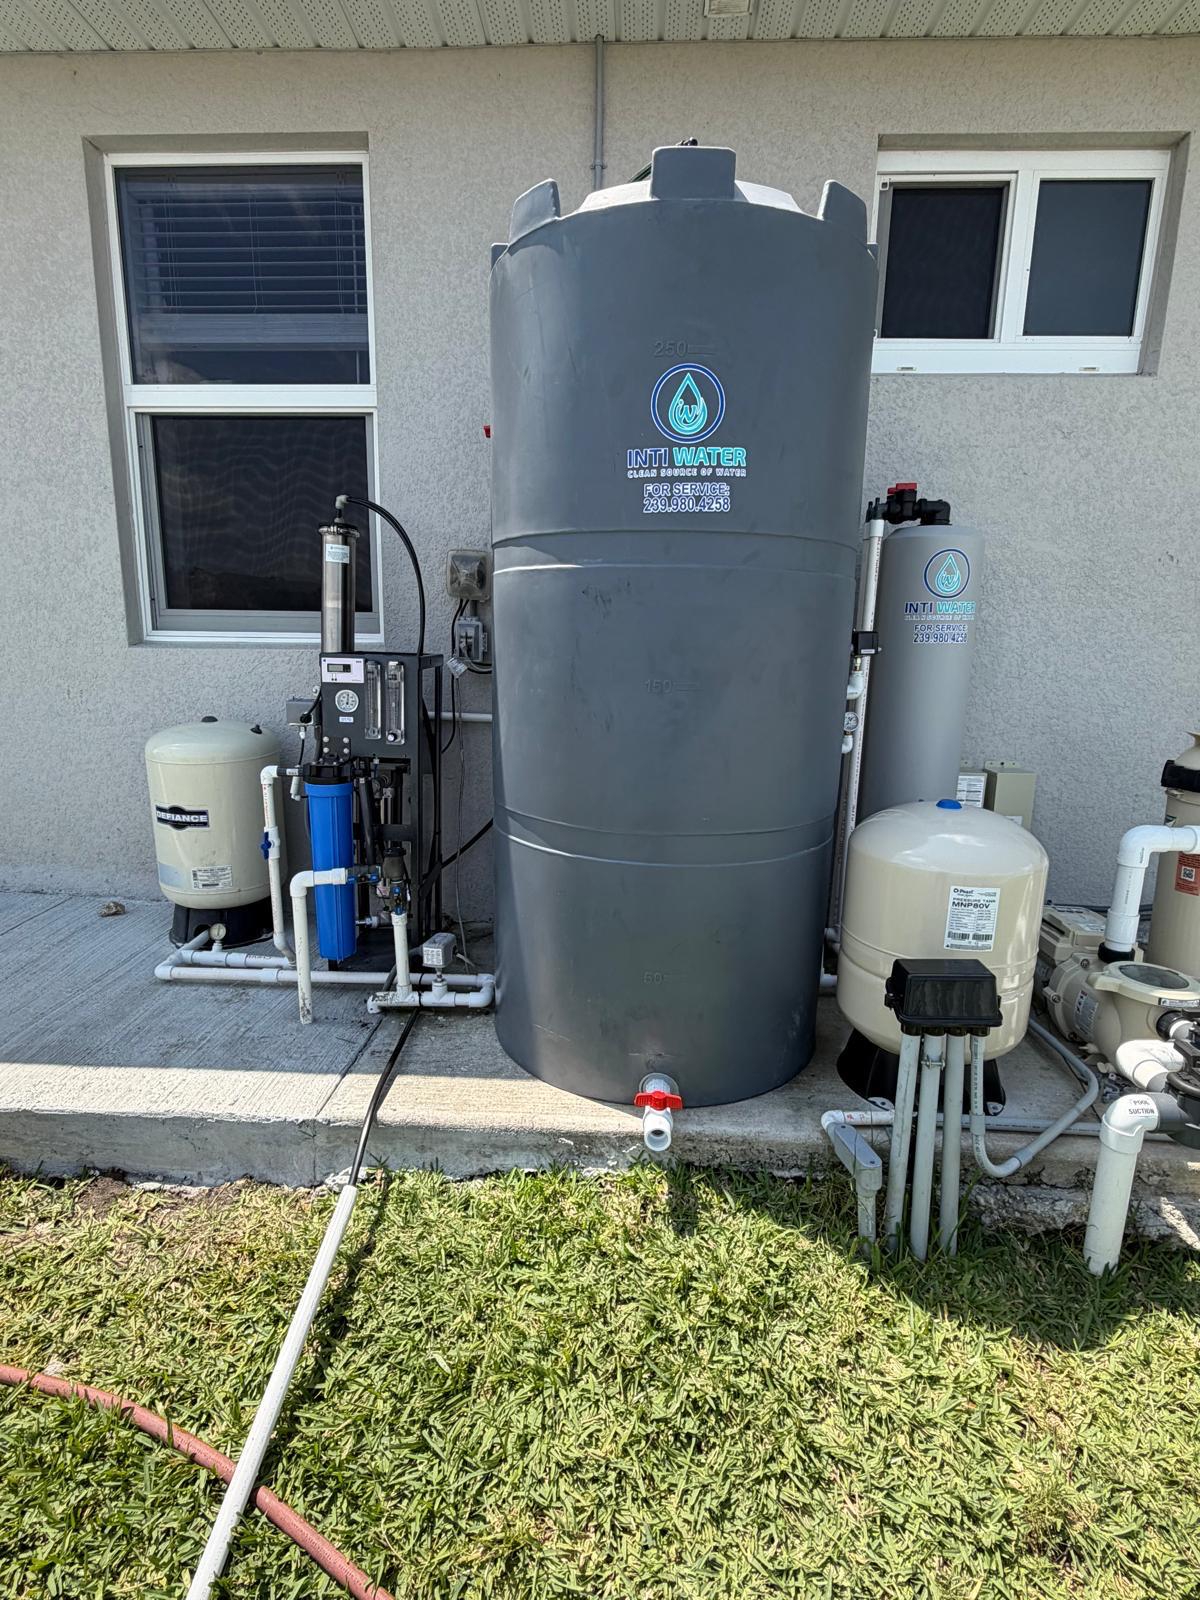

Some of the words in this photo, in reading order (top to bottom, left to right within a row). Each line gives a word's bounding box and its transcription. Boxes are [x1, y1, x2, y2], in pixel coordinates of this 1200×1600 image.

[654, 340, 688, 358] 250
[627, 448, 668, 468] INTI
[672, 447, 747, 467] WATER
[627, 469, 657, 478] CLEAN
[660, 468, 697, 477] SOURCE
[700, 468, 713, 477] OF
[716, 467, 747, 477] WATER
[643, 483, 670, 496] FOR
[673, 481, 730, 496] SERVICE:
[643, 496, 731, 513] 239.980.4258
[904, 602, 933, 614] INTI
[937, 601, 976, 614] WATER
[914, 624, 933, 632] FOR
[156, 810, 208, 822] DEFIANCE
